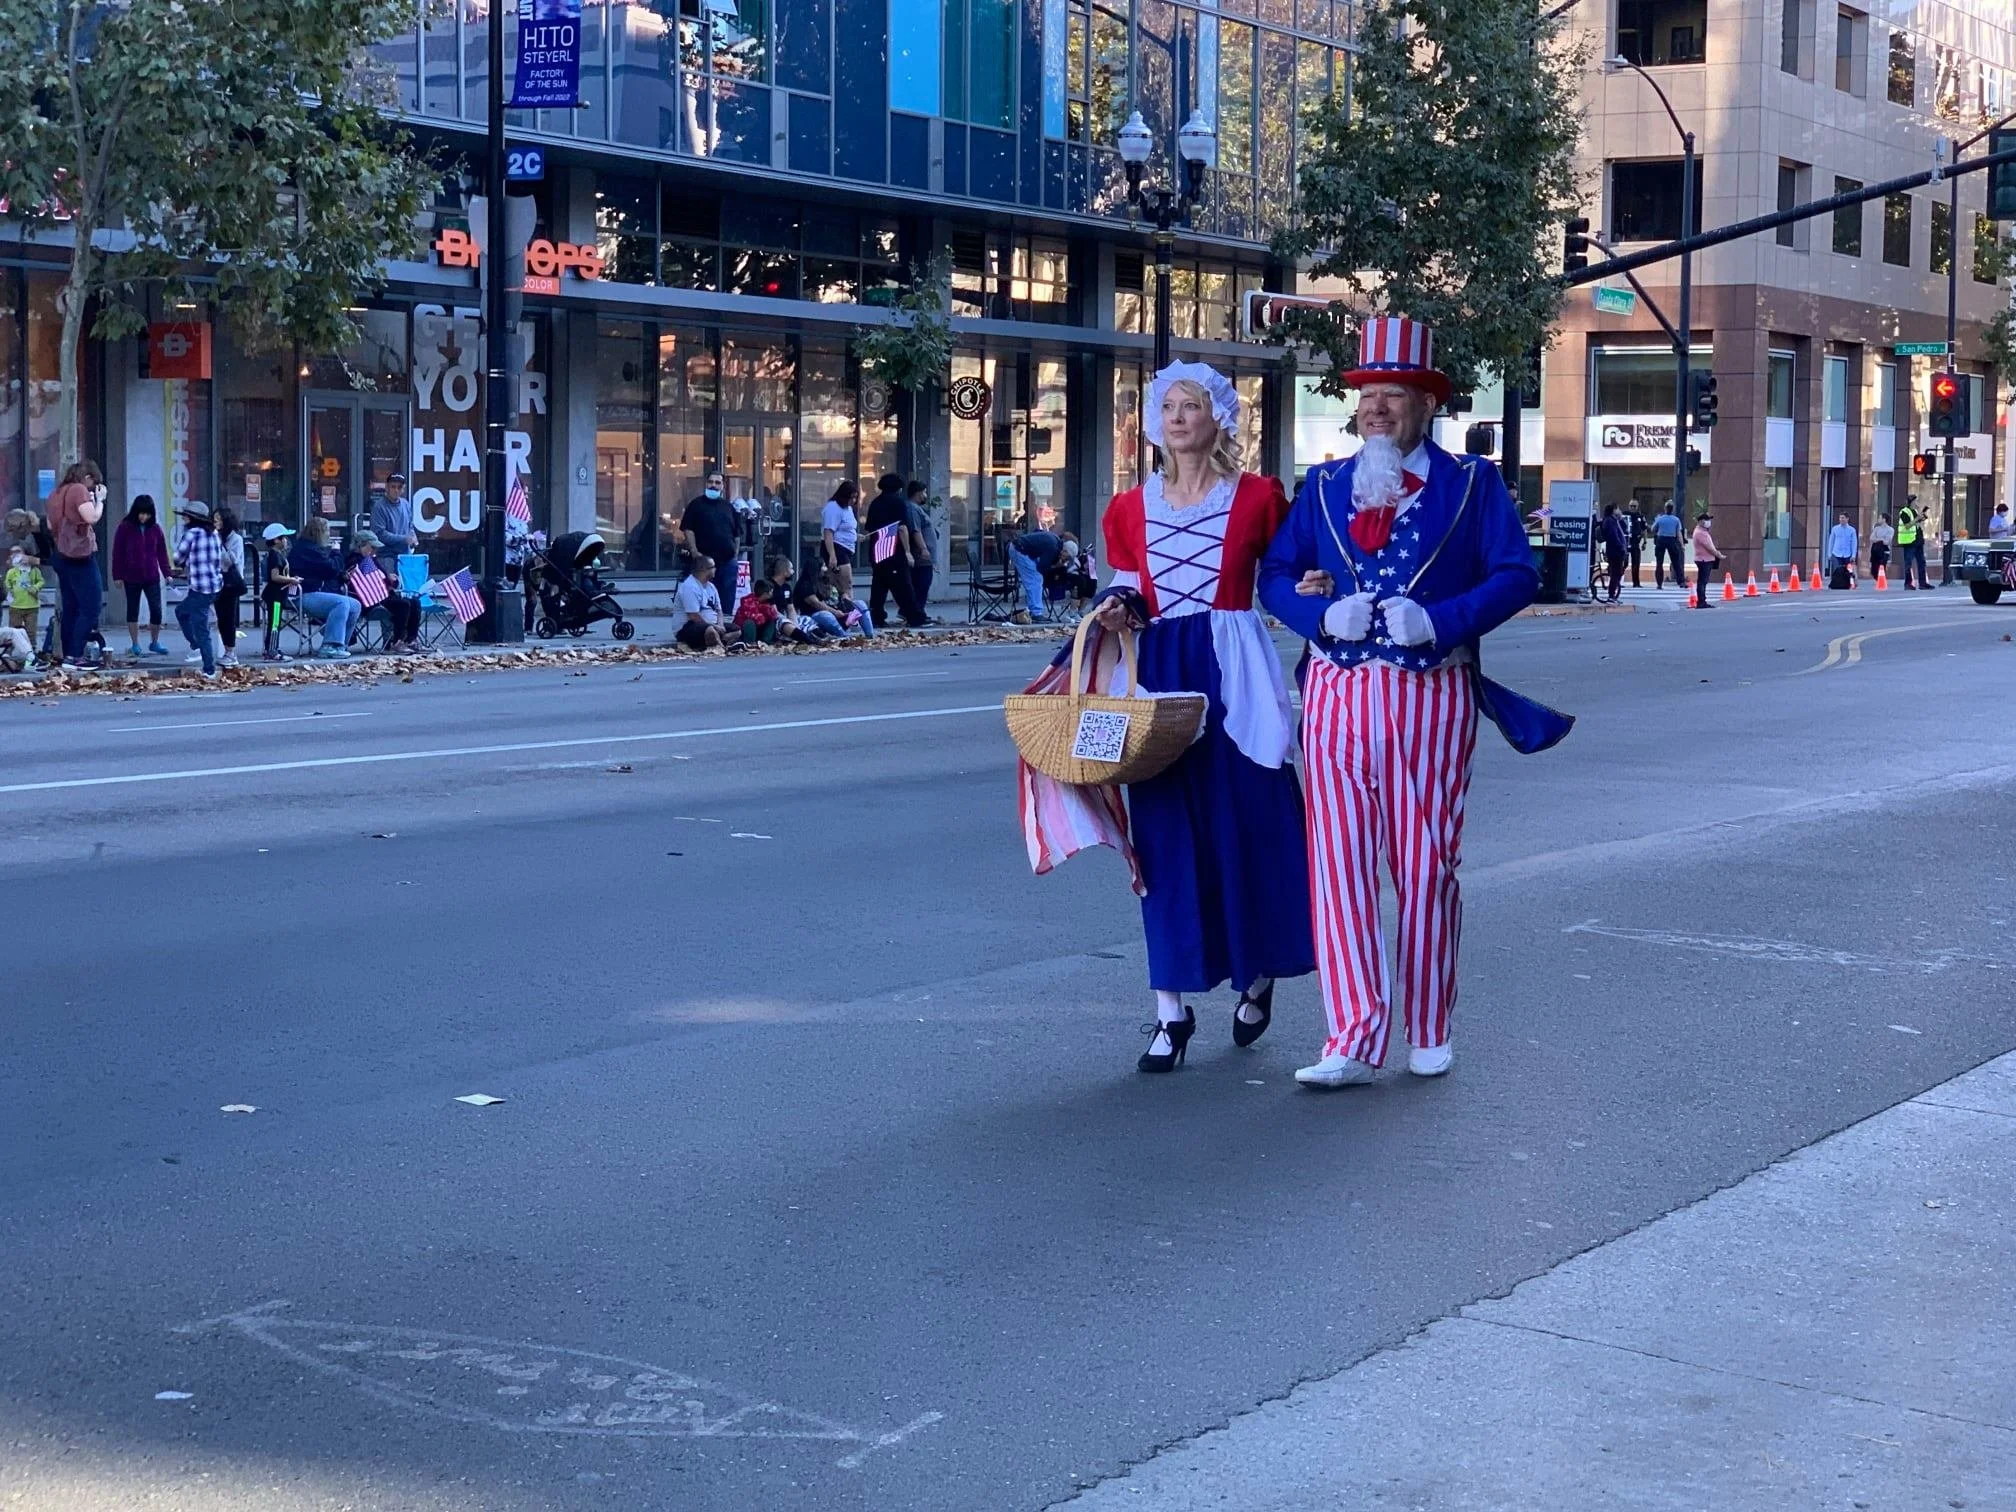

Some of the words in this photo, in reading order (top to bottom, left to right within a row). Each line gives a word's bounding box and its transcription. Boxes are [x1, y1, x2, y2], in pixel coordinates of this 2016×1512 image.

[524, 25, 574, 49] HITO
[523, 50, 573, 64] STEYERL
[530, 69, 565, 78] FACTORY
[525, 80, 536, 89] OF
[537, 80, 551, 88] THE
[552, 79, 568, 88] SUN
[507, 152, 541, 175] 2C
[436, 228, 605, 280] BIOPS
[1902, 345, 1916, 353] San
[1917, 345, 1938, 353] Pedro
[413, 364, 547, 415] YOR
[950, 377, 985, 396] CHIPOTLE
[1637, 424, 1693, 438] FREMO
[1637, 436, 1672, 449] BANK
[412, 428, 532, 474] HAR
[412, 487, 481, 533] CU
[1553, 520, 1587, 530] Leasing
